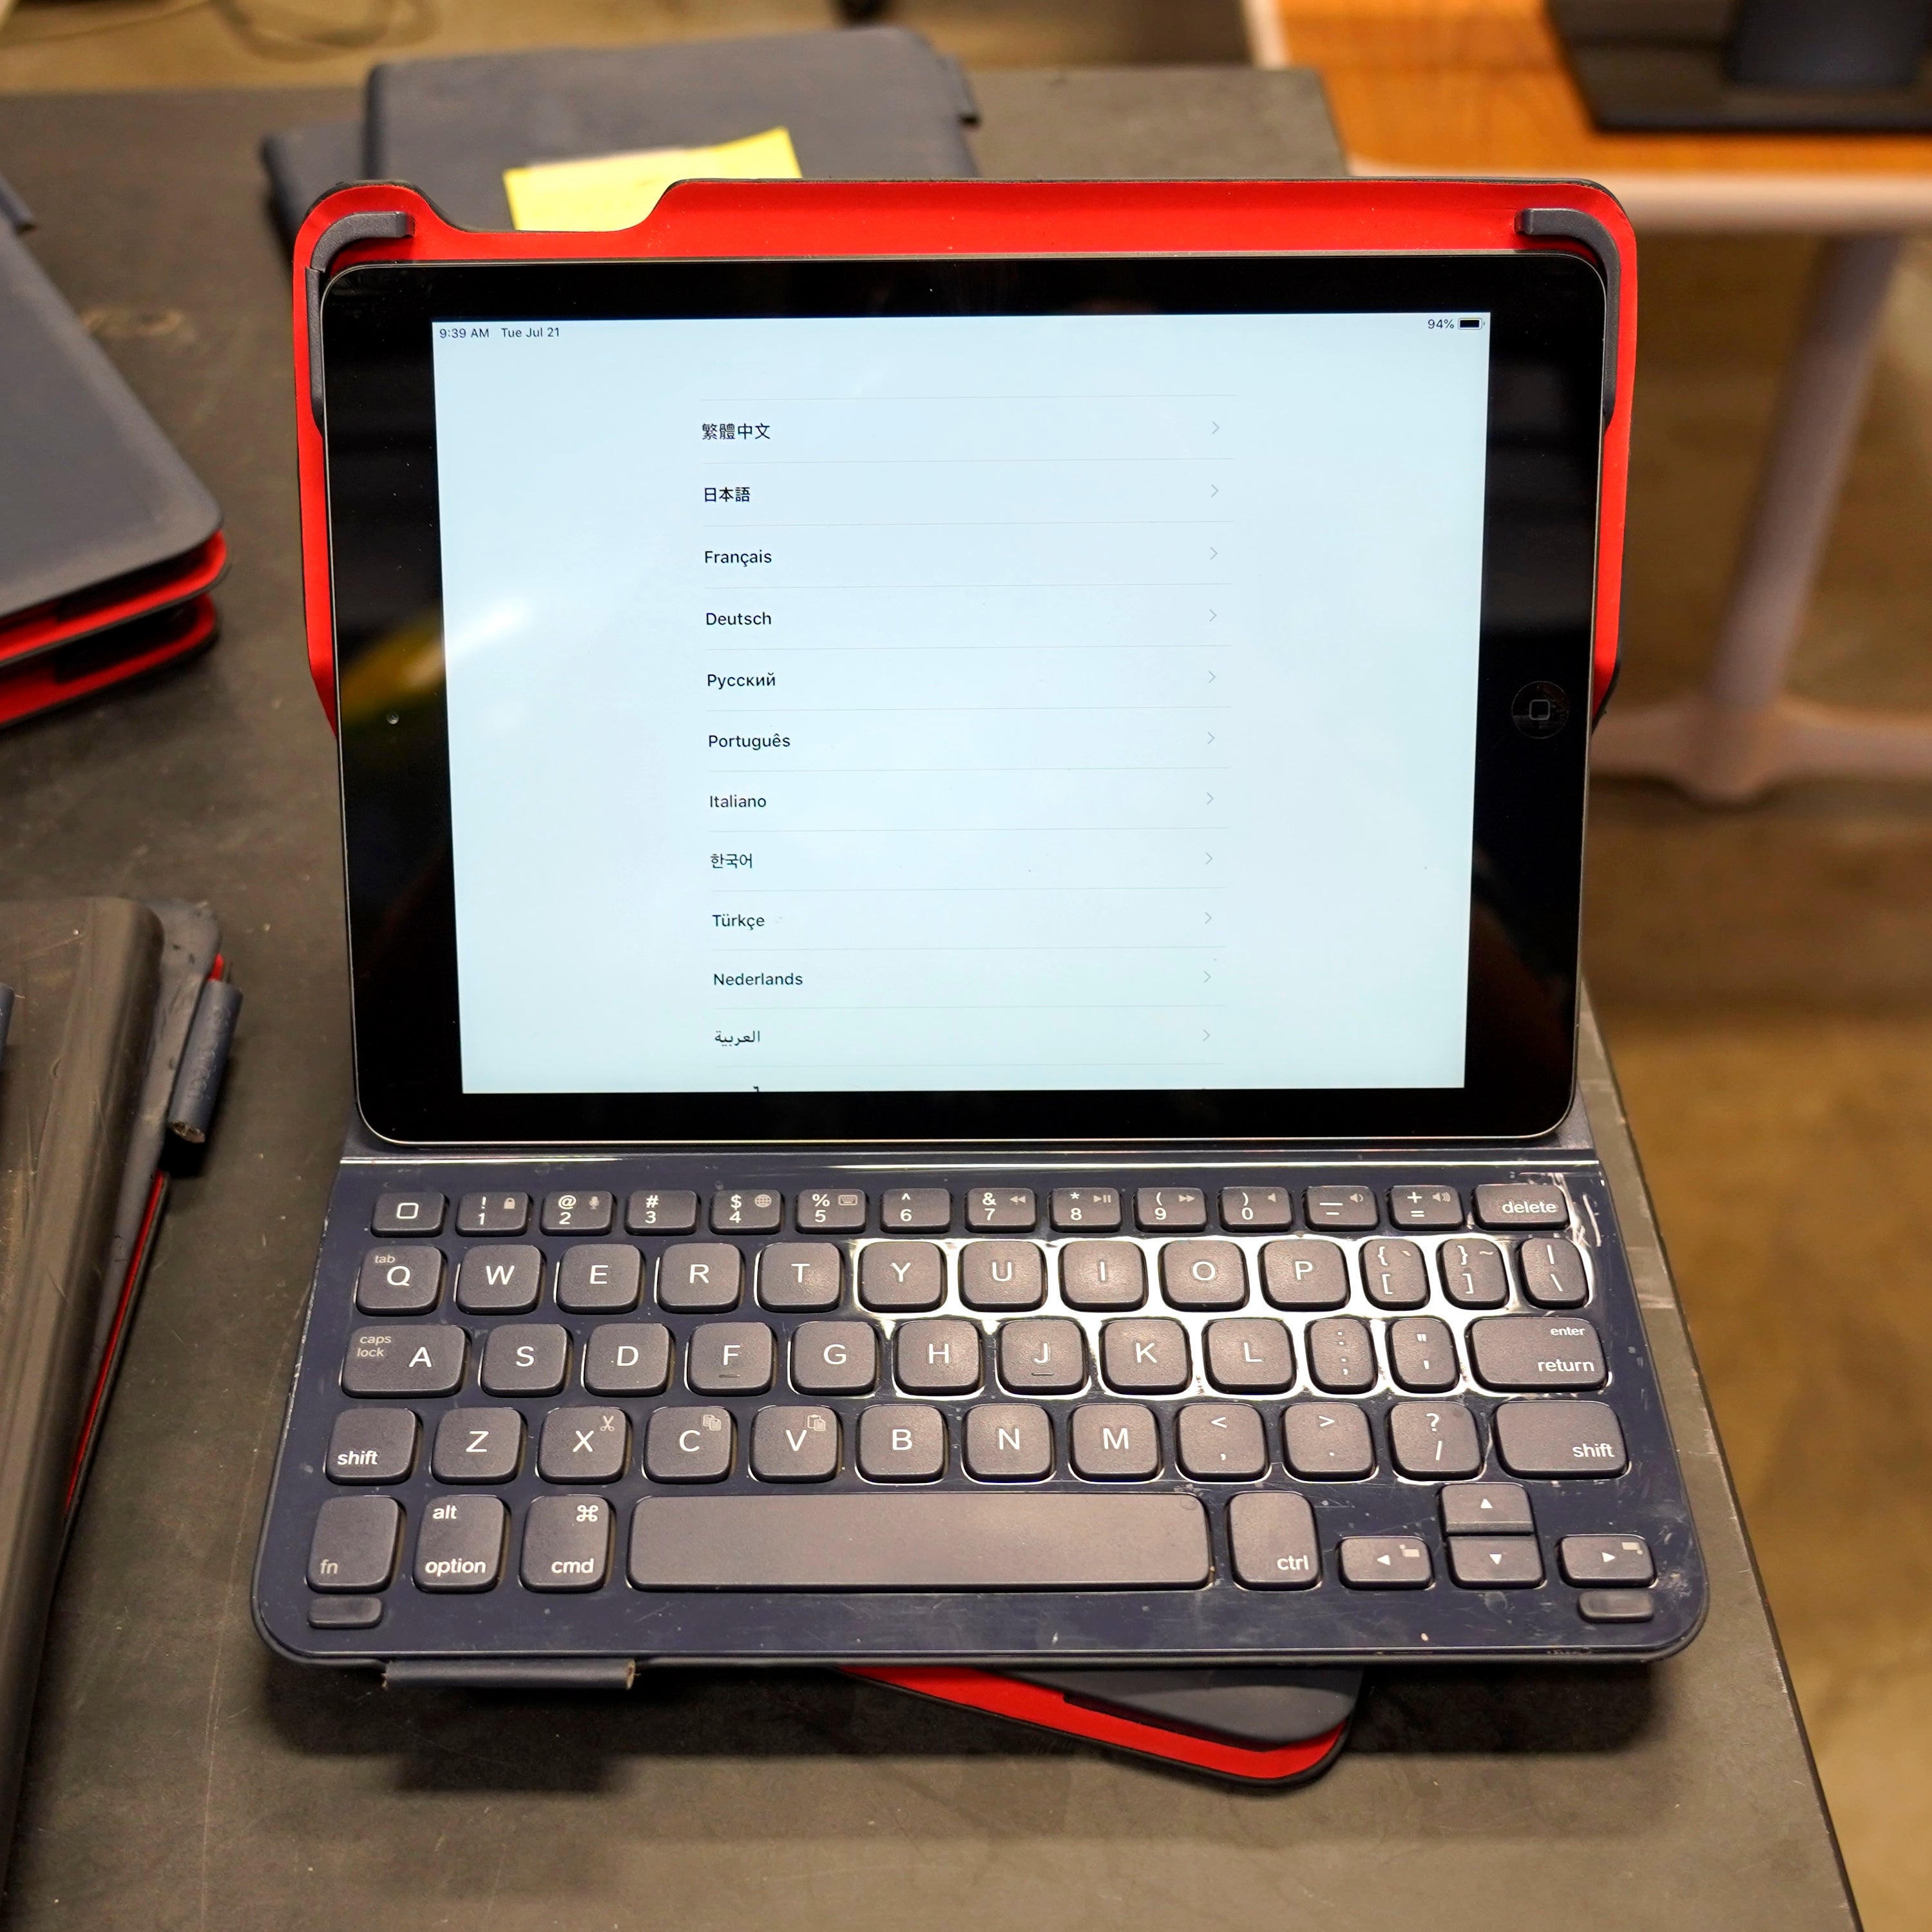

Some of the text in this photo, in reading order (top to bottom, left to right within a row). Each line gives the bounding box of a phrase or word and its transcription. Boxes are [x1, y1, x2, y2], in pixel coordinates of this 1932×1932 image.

[501, 327, 559, 338] Tue Jul 21
[1428, 319, 1455, 329] 94%
[439, 328, 489, 339] 9:39 AM
[702, 423, 770, 441] 繁體中文
[704, 486, 751, 502] 日本語
[705, 549, 772, 568] Français
[706, 611, 771, 626] Deutsch
[707, 672, 776, 690] Русский
[709, 733, 790, 751] Português
[710, 794, 767, 808] Italiano
[711, 853, 752, 869] 한국어
[712, 914, 765, 930] Türkçe
[714, 973, 803, 986] Nederlands
[714, 1030, 760, 1046] العربية
[814, 1209, 827, 1223] 5
[900, 1209, 912, 1222] 6
[984, 1208, 996, 1221] 7
[1070, 1207, 1082, 1221] 8
[1154, 1207, 1167, 1221] 9
[1241, 1207, 1254, 1220] 0
[1502, 1201, 1557, 1214] delete
[478, 1212, 485, 1225] 1
[559, 1211, 571, 1225] 2
[645, 1210, 656, 1224] 3
[729, 1210, 741, 1223] 4
[374, 1254, 396, 1264] tab
[387, 1265, 411, 1286] Q
[486, 1265, 515, 1285] W
[589, 1265, 609, 1285] E
[689, 1264, 709, 1284] R
[791, 1263, 810, 1283] T
[890, 1262, 912, 1283] Y
[991, 1261, 1012, 1282] U
[1100, 1261, 1106, 1281] I
[1192, 1261, 1216, 1281] O
[1295, 1261, 1313, 1281] P
[1550, 1326, 1585, 1336] enter
[359, 1335, 392, 1346] caps
[357, 1347, 384, 1357] lock
[408, 1346, 432, 1368] A
[516, 1346, 535, 1367] S
[617, 1346, 639, 1366] D
[723, 1344, 741, 1366] F
[823, 1344, 846, 1365] G
[928, 1343, 952, 1364] H
[1034, 1343, 1051, 1364] J
[1136, 1343, 1160, 1363] K
[1243, 1342, 1263, 1363] L
[1537, 1359, 1595, 1372] return
[466, 1431, 489, 1453] Z
[572, 1430, 595, 1453] X
[679, 1430, 701, 1452] C
[785, 1429, 807, 1451] V
[892, 1429, 913, 1451] B
[999, 1428, 1020, 1450] N
[1103, 1428, 1129, 1449] M
[337, 1449, 378, 1466] shift
[1572, 1442, 1615, 1458] shift
[432, 1504, 457, 1520] alt
[320, 1559, 338, 1574] fn
[425, 1558, 486, 1577] option
[551, 1558, 595, 1574] cmd
[1277, 1554, 1309, 1571] ctrl
